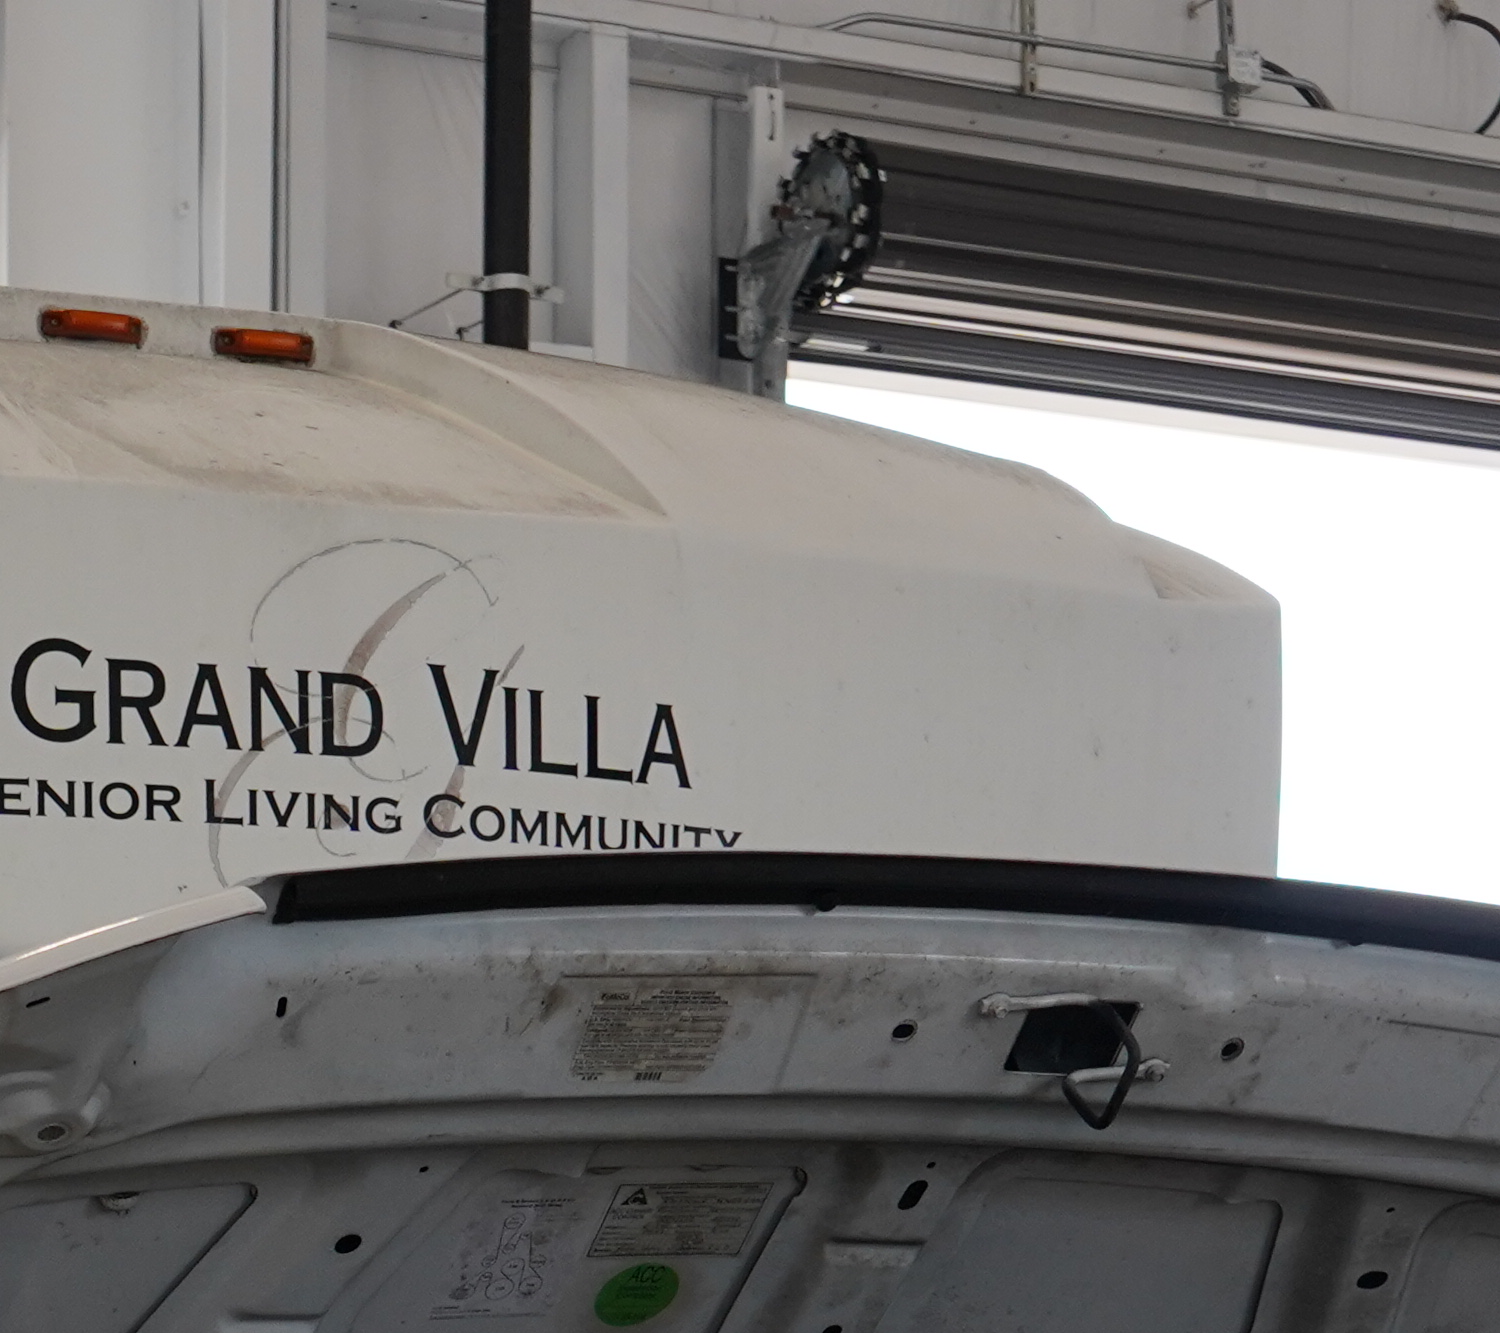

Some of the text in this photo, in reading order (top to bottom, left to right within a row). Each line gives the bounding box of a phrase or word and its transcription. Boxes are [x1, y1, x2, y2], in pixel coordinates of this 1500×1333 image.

[11, 637, 693, 789] GRAND VILLA
[204, 777, 401, 836] LIVING
[423, 793, 743, 852] COMMUNITY
